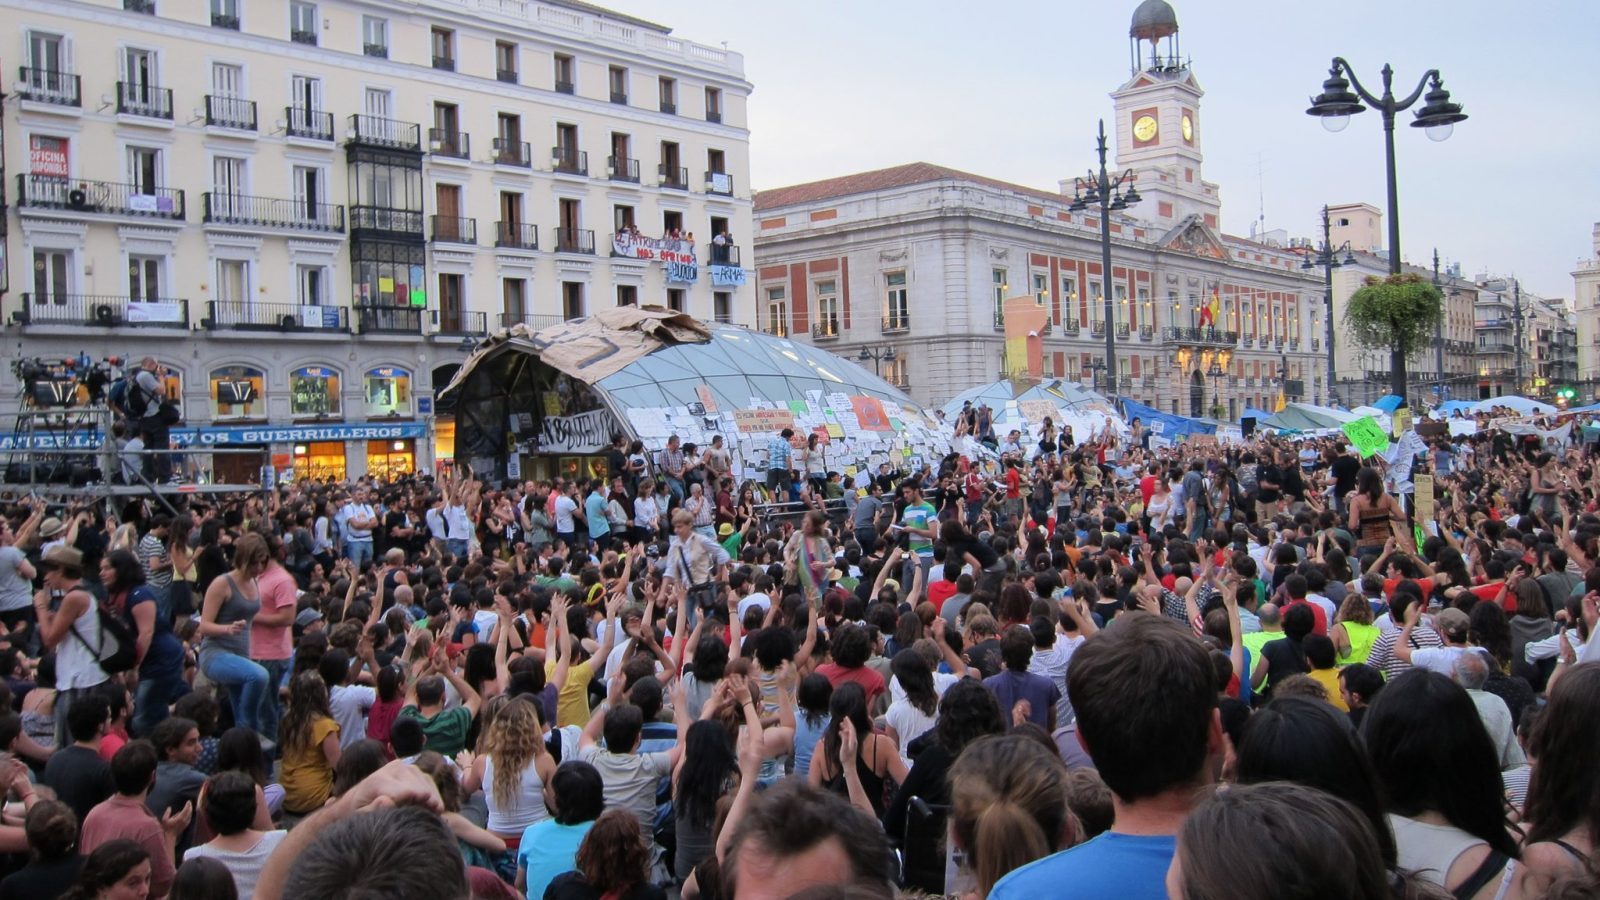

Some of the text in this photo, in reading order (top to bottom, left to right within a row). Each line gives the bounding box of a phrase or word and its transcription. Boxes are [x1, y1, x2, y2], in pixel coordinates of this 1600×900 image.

[31, 151, 66, 163] OFICINA
[242, 427, 401, 442] GUERRILLEROS
[544, 418, 566, 445] NO
